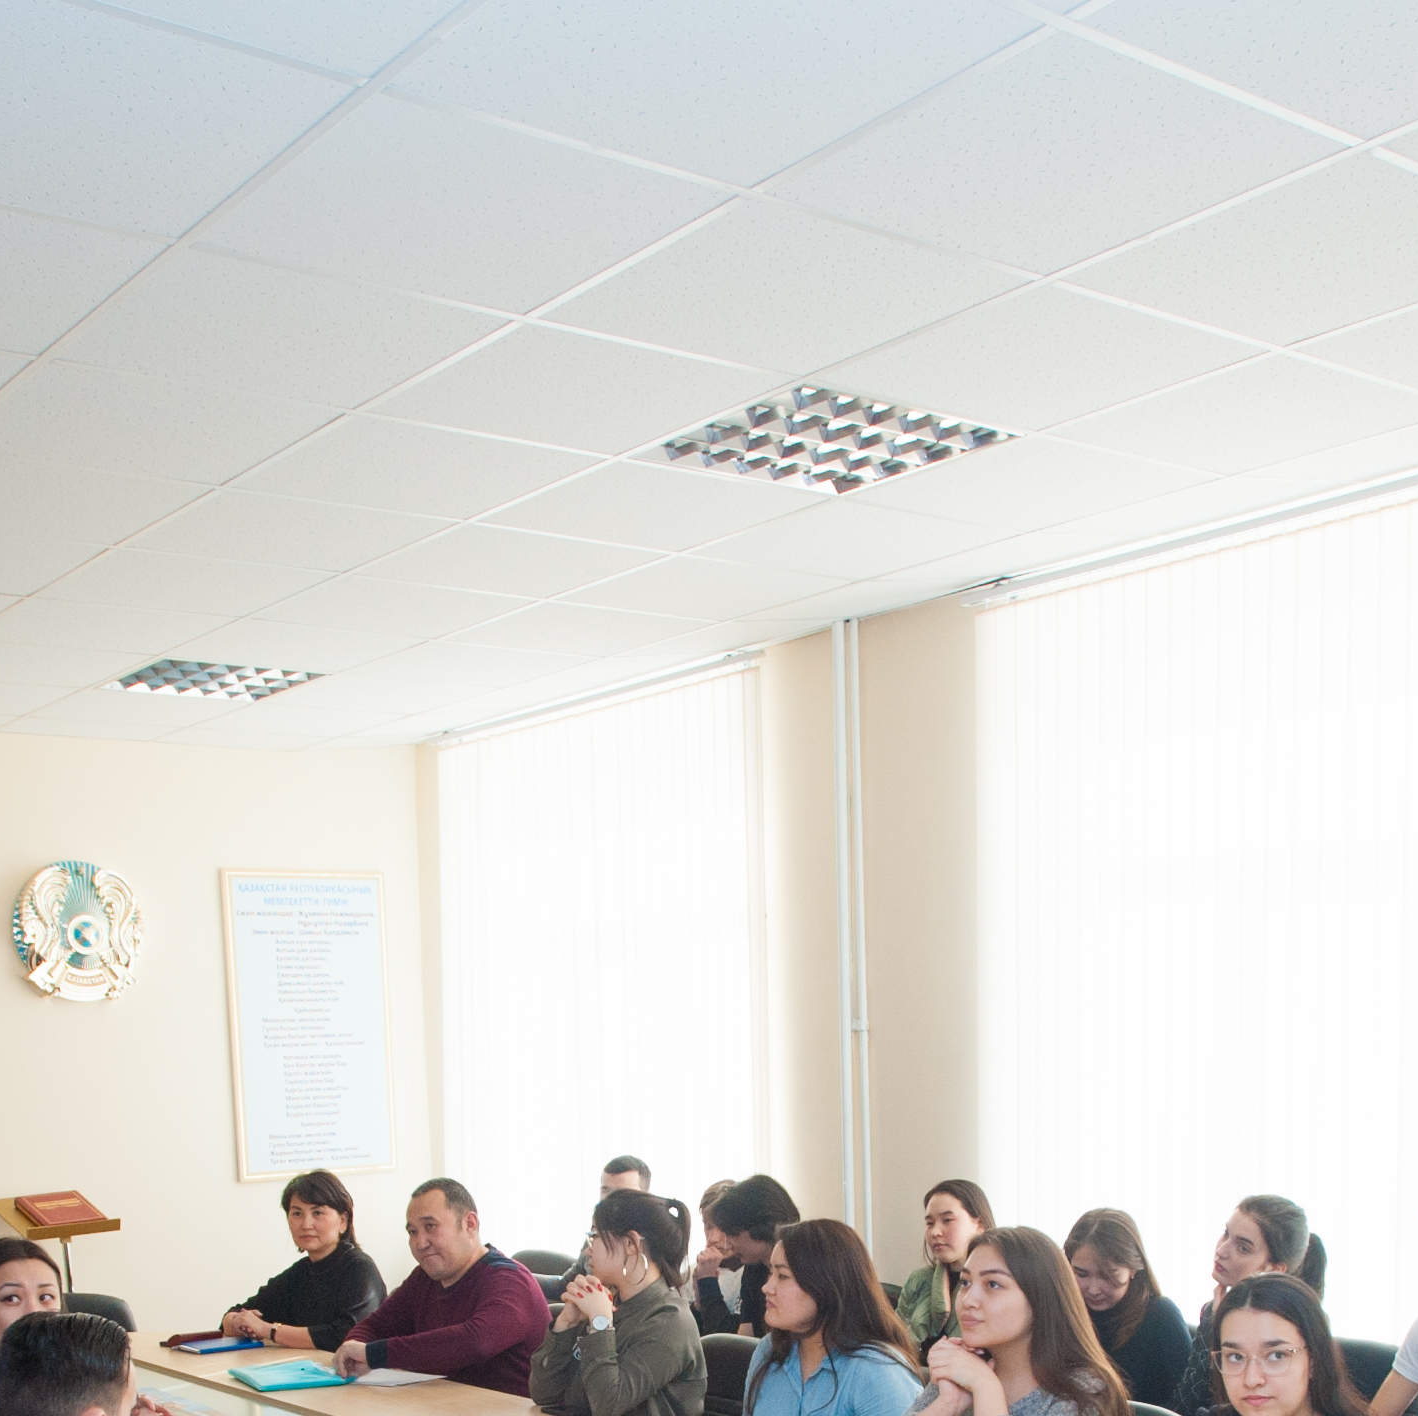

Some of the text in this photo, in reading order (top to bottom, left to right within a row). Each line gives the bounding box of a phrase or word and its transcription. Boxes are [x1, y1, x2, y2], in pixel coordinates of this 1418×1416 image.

[238, 883, 371, 896] ҚАЗАҚСТАН РЕСПУБЛИКАСЫНЫҢ
[263, 897, 320, 906] МЕМЛЕКЕТТІК
